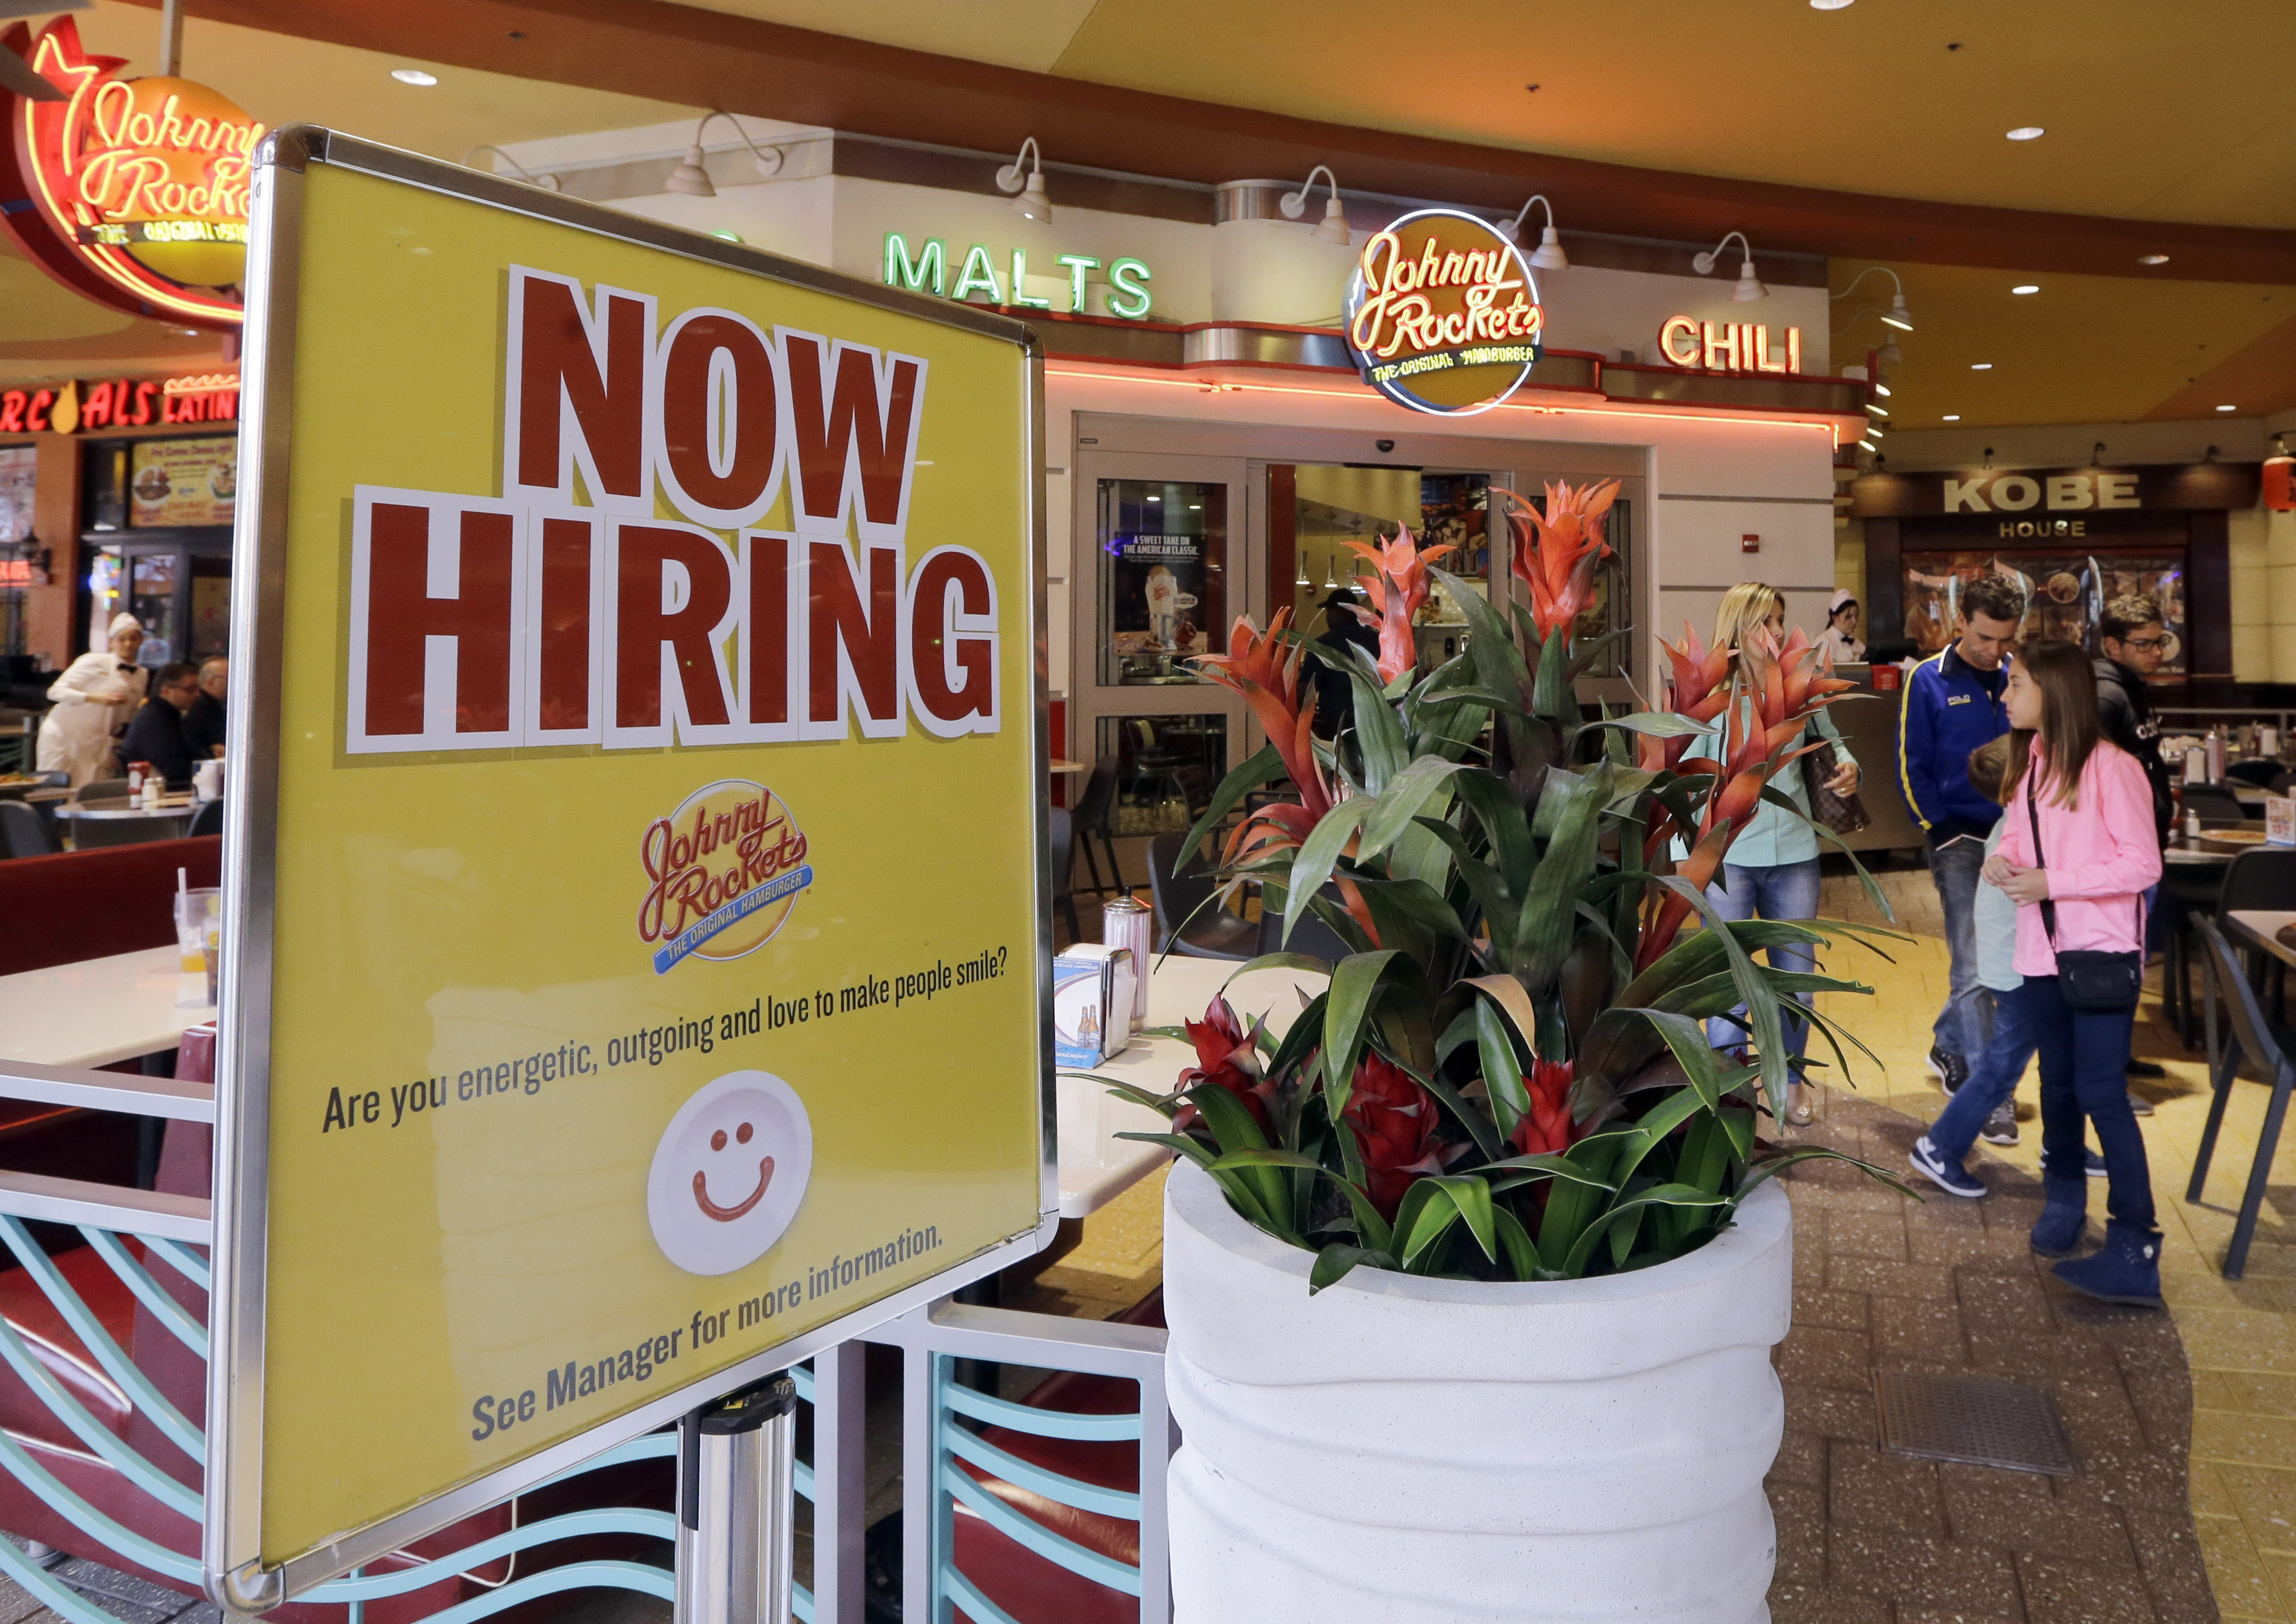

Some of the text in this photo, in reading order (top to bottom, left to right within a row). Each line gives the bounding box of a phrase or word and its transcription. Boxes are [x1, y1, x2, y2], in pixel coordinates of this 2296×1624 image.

[80, 81, 265, 205] Johnny
[105, 156, 250, 217] Rocke
[883, 231, 1152, 318] MALTS
[1351, 231, 1524, 352] Johnny
[1372, 365, 1399, 382] THE
[1459, 346, 1535, 365] HAMBURGER
[1376, 290, 1544, 357] Rockets
[1658, 314, 1800, 374] CHILI
[511, 268, 926, 533] NOW
[1944, 474, 2142, 513] KOBE
[1999, 520, 2086, 538] HOUSE
[1123, 544, 1136, 554] THE
[1137, 545, 1171, 555] AMERICAN
[1133, 535, 1190, 545] A SWEET TAKE ON
[357, 495, 996, 740] HIRING
[1948, 694, 1970, 705] POLO
[639, 787, 783, 943] Johnny
[661, 826, 808, 941] Rockets
[666, 872, 803, 961] THE ORIGINAL HAMBURGER
[322, 946, 1008, 1133] Are you energetic, outgoing and love to make people smile?
[472, 1224, 943, 1442] See Manager for more information.
